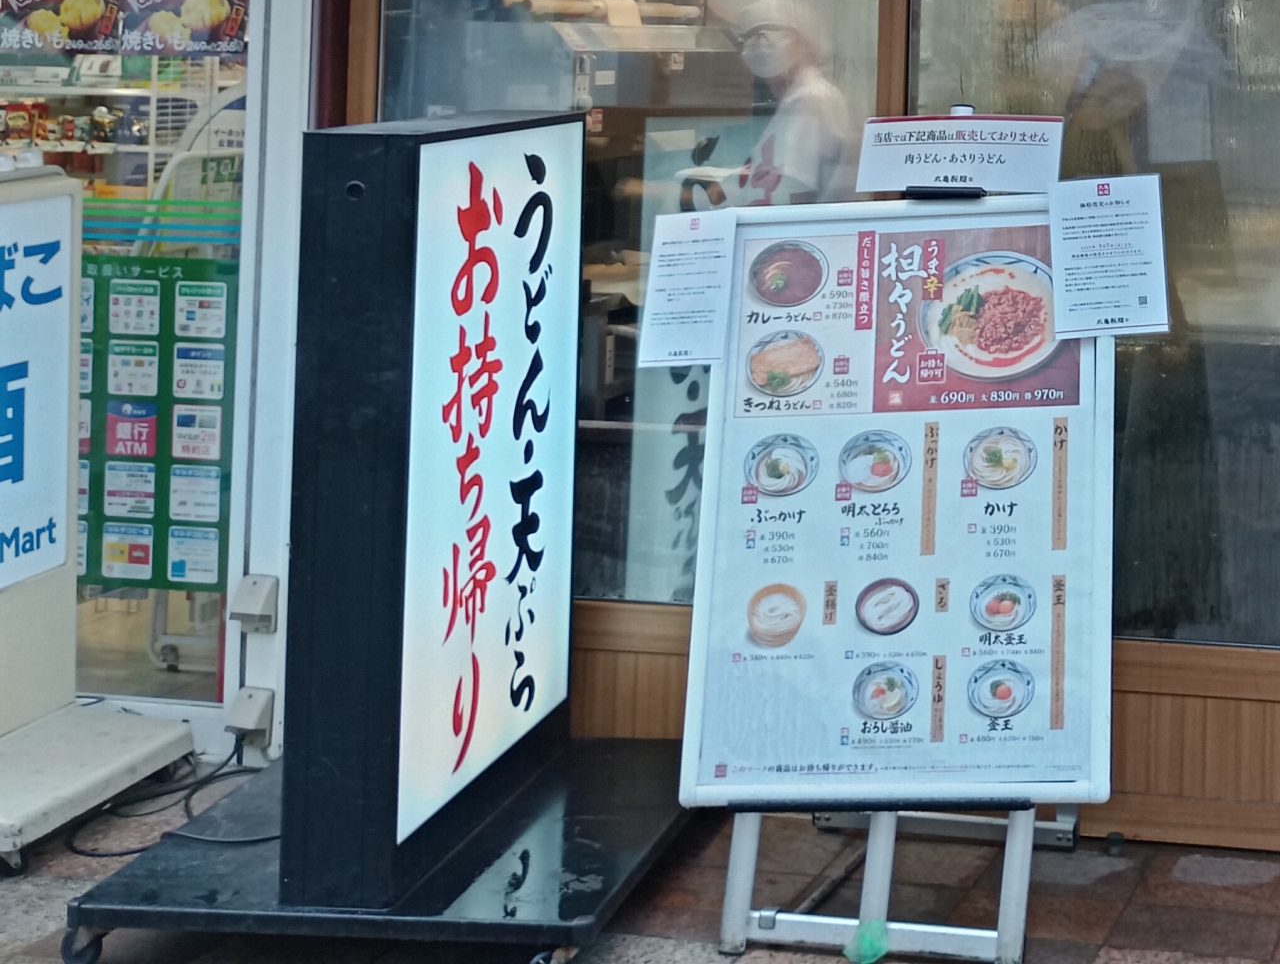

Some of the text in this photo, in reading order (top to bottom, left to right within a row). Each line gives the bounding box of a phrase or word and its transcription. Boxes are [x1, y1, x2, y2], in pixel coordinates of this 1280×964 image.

[873, 130, 1049, 143] 当店では下記商品は販売しておりません
[904, 153, 1006, 165] 肉うどん・あさりうどん
[923, 240, 943, 298] うま辛
[746, 311, 811, 324] カレーうどん
[743, 398, 810, 412] きつねうどん
[115, 422, 149, 440] 銀行
[505, 153, 554, 712] うどん・天ぷら
[1054, 424, 1068, 450] かけ
[114, 443, 148, 455] ATM
[442, 161, 503, 777] お持ち帰り
[750, 508, 806, 523] ぶっかけ
[984, 501, 1017, 516] かけ
